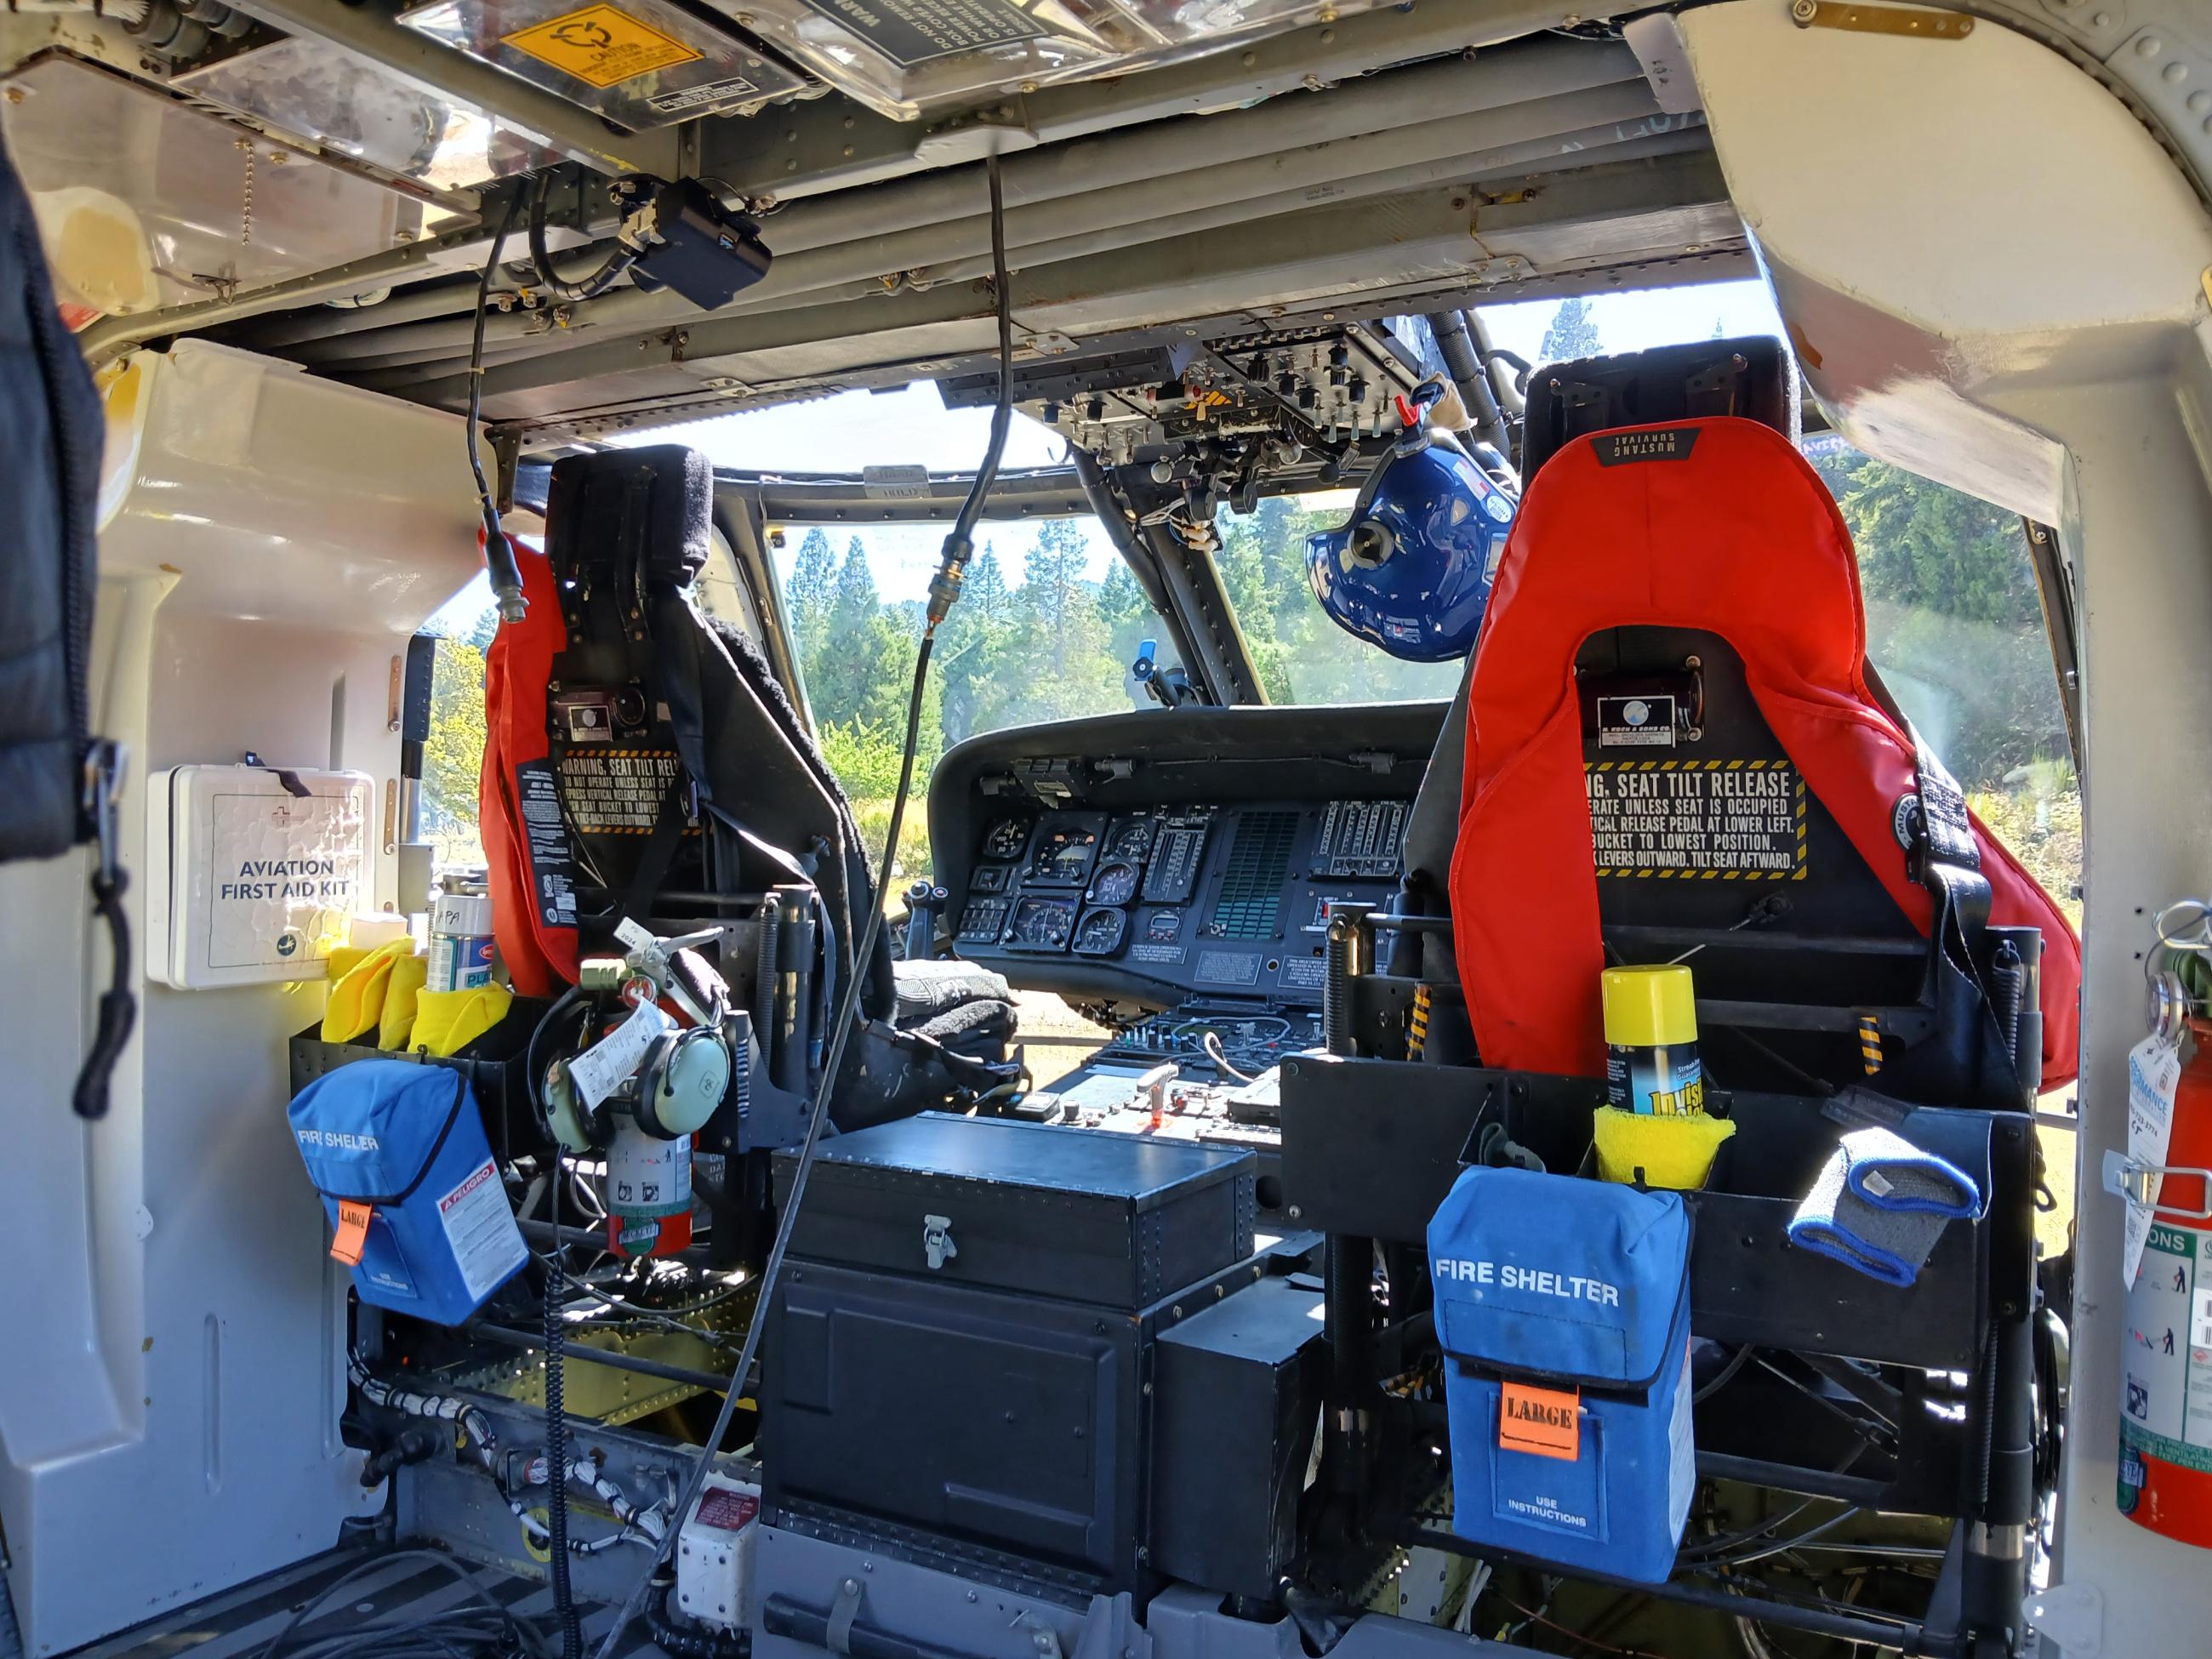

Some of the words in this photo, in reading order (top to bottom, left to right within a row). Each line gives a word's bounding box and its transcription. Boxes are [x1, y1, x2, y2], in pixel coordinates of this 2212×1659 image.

[913, 7, 947, 29] COVER
[952, 5, 986, 27] WHILE
[910, 21, 937, 37] NOT
[944, 29, 969, 45] BOX
[948, 17, 985, 42] POWER
[983, 27, 1000, 38] OR
[934, 37, 953, 48] DO
[1615, 432, 1674, 446] SURVIVAL
[1614, 442, 1675, 457] MUSTANG
[609, 758, 631, 776] SEAT
[634, 758, 653, 776] TILT
[614, 777, 638, 788] UNLESS
[641, 777, 655, 788] SEAT
[1617, 772, 1660, 798] SEAT
[1668, 772, 1702, 798] TILT
[1712, 772, 1790, 798] RELEASE
[1625, 799, 1669, 815] UNLESS
[1675, 799, 1703, 815] SEAT
[1710, 799, 1721, 815] IS
[1727, 799, 1787, 815] OCCUPIED
[1621, 817, 1665, 832] RELEASE
[1670, 817, 1703, 833] PEDAL
[1707, 817, 1721, 833] AT
[1725, 817, 1763, 833] LOWER
[1767, 817, 1794, 834] LEFT.
[1639, 833, 1654, 849] TO
[1661, 834, 1707, 850] LOWEST
[1713, 834, 1776, 851] POSITION.
[240, 860, 334, 877] AVIATION
[1599, 851, 1634, 866] LEVERS
[1636, 851, 1690, 867] OUTWARD.
[1691, 852, 1712, 868] TILT
[1713, 852, 1739, 868] SEAT
[1740, 852, 1795, 869] AFTWARD.
[221, 883, 276, 899] FIRST
[281, 881, 315, 898] AID
[321, 881, 350, 896] KIT
[453, 1167, 491, 1203] PELIGRO
[341, 1208, 366, 1229] LARGE
[1436, 1258, 1494, 1284] FIRE
[1501, 1265, 1620, 1307] SHELTER
[1507, 1397, 1572, 1429] LARGE
[1536, 1496, 1558, 1509] USE
[1508, 1499, 1587, 1527] INSTRUCTIONS
